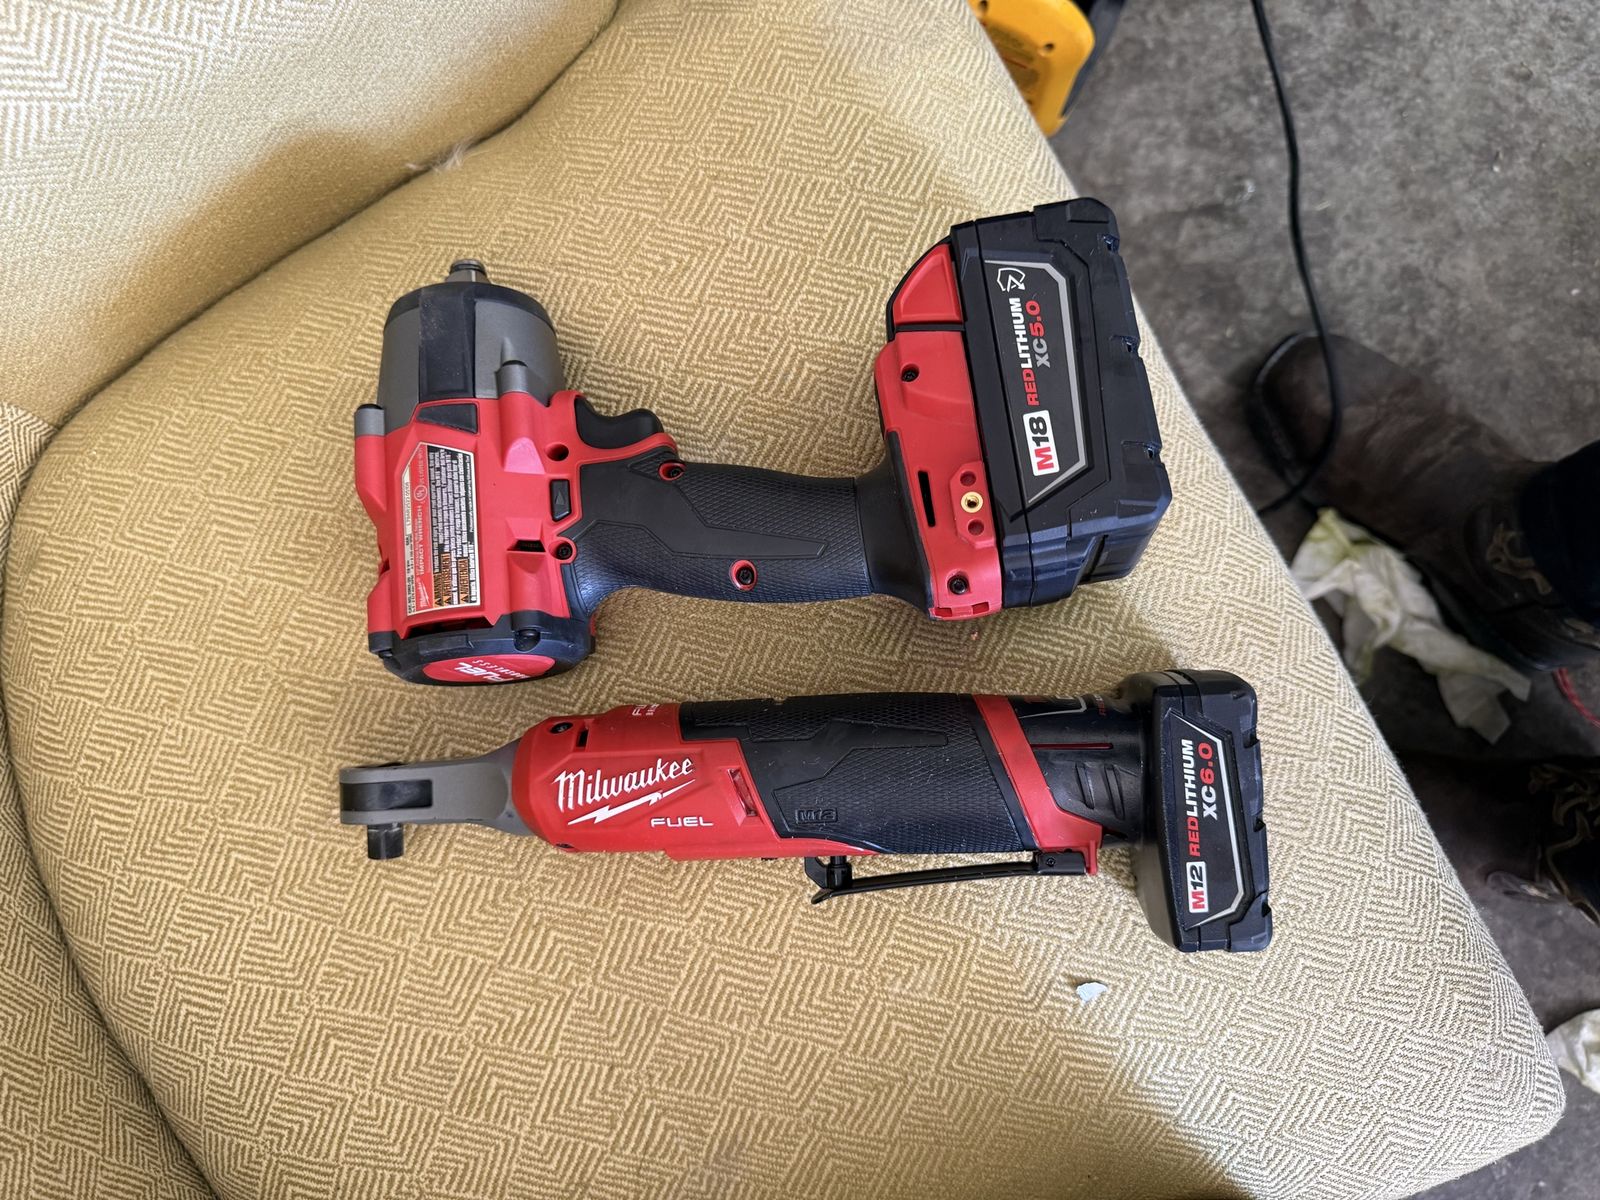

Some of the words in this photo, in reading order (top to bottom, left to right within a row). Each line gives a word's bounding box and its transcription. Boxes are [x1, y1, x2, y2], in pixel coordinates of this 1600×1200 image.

[1009, 297, 1040, 406] REDLITHIUM
[1025, 300, 1051, 368] XC5.0
[1029, 416, 1054, 470] M18
[416, 506, 424, 543] WRENCH
[551, 757, 693, 813] Milwaukee
[1181, 739, 1201, 857] REDLITHIUM
[1198, 742, 1218, 820] XC6.0
[650, 816, 713, 828] FUEL
[1190, 864, 1205, 910] M12
